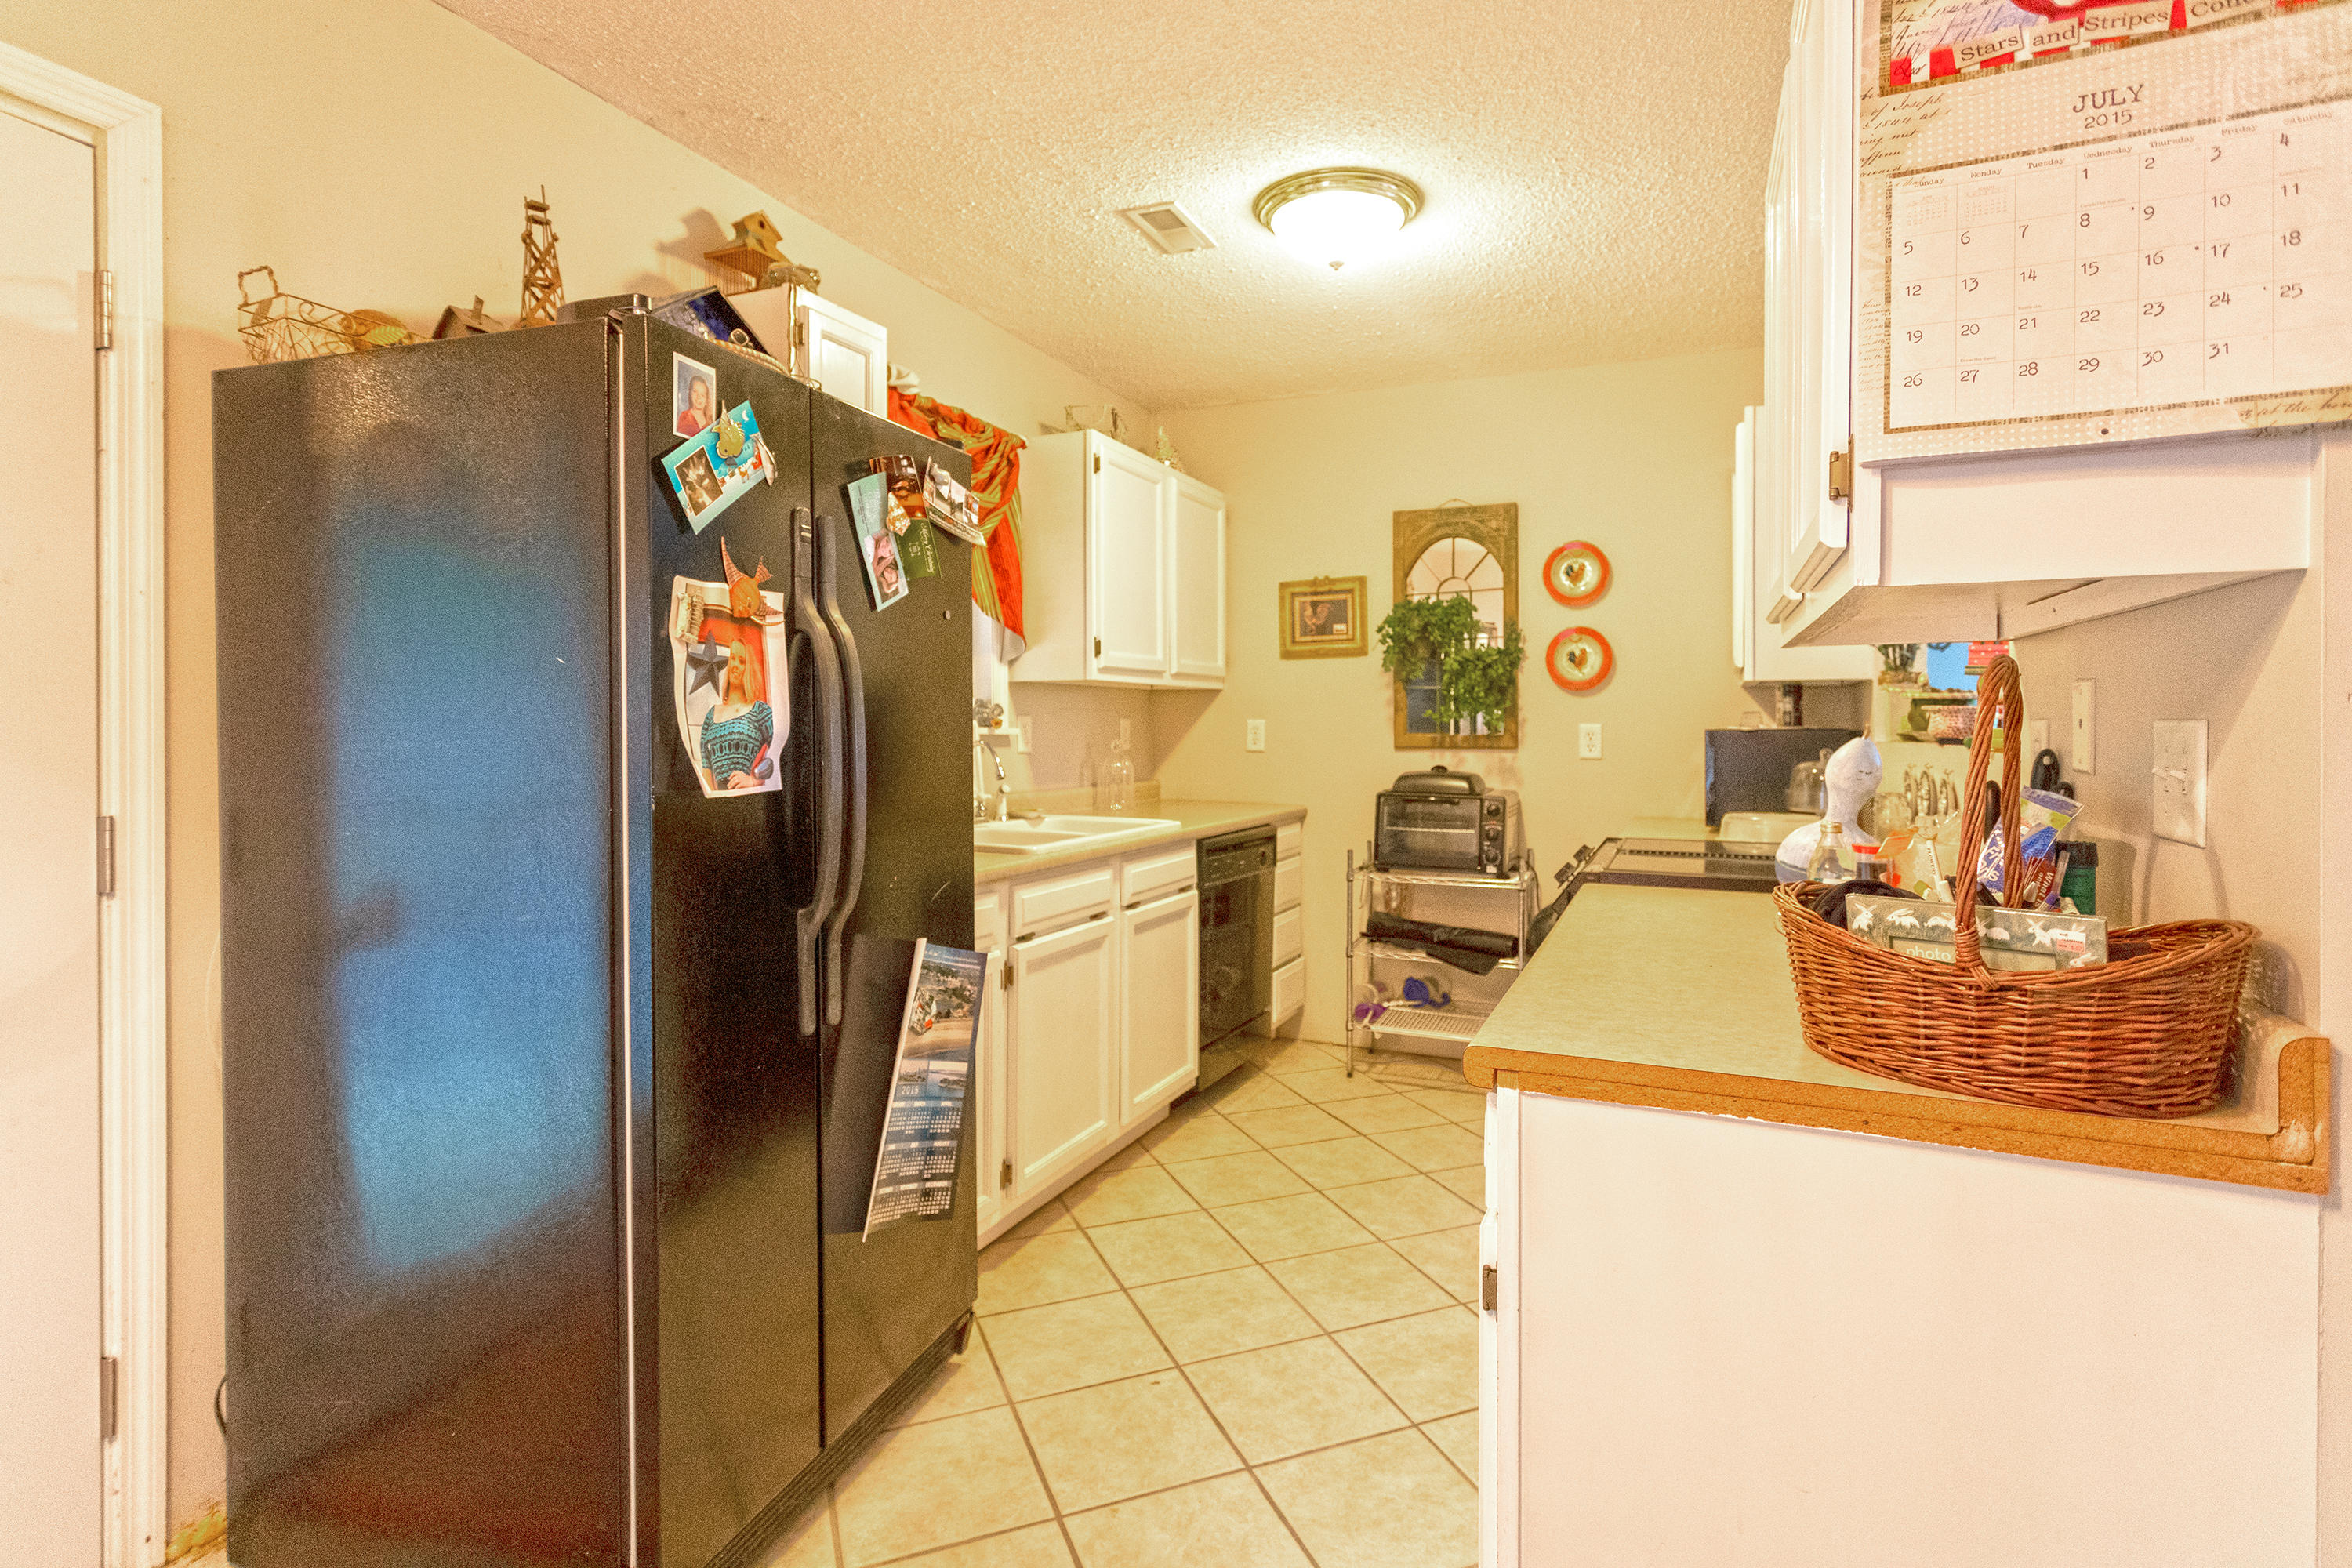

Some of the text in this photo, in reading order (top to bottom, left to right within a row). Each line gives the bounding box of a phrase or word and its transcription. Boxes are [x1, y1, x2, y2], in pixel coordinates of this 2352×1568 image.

[1960, 36, 2019, 62] Stars
[2033, 25, 2076, 46] and
[2085, 9, 2169, 31] Stripes
[2073, 84, 2144, 114] JULY
[2084, 109, 2132, 129] 2015
[1914, 176, 1944, 187] Sunday
[1970, 169, 2002, 179] Monday
[2027, 158, 2065, 169] Tuesday
[2083, 146, 2132, 160] Wednesday
[2149, 135, 2195, 149] Thursday
[2221, 125, 2257, 136] Friday
[2082, 132, 2289, 180] 1 2 3 4
[1904, 182, 2299, 255] 5 6 7 8 9 10 11
[1906, 230, 2302, 296] 12 13 14 15 16 17 18
[1907, 283, 2303, 343] 19 20 21 22 23 24 25
[1904, 343, 2229, 387] 26 27 28 29 30 31
[901, 1085, 920, 1095] 2015
